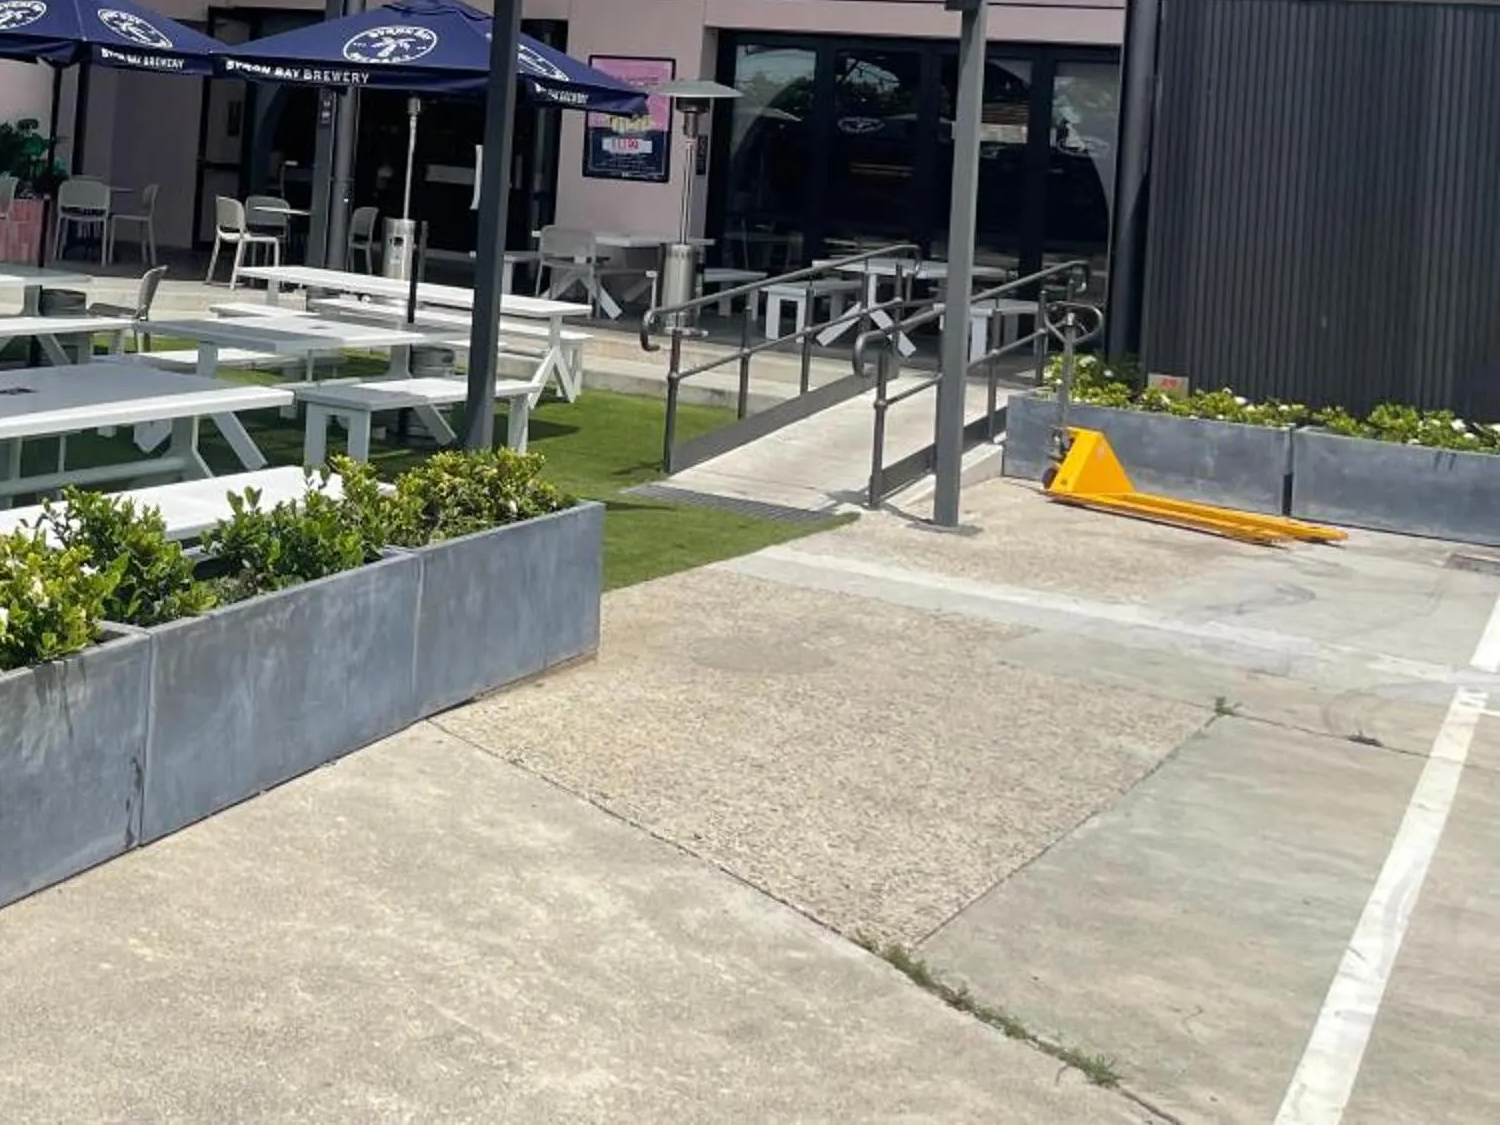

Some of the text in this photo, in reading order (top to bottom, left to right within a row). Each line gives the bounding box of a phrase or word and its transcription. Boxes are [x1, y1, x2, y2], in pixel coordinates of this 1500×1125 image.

[225, 60, 369, 84] BYRON BAY BREWERY
